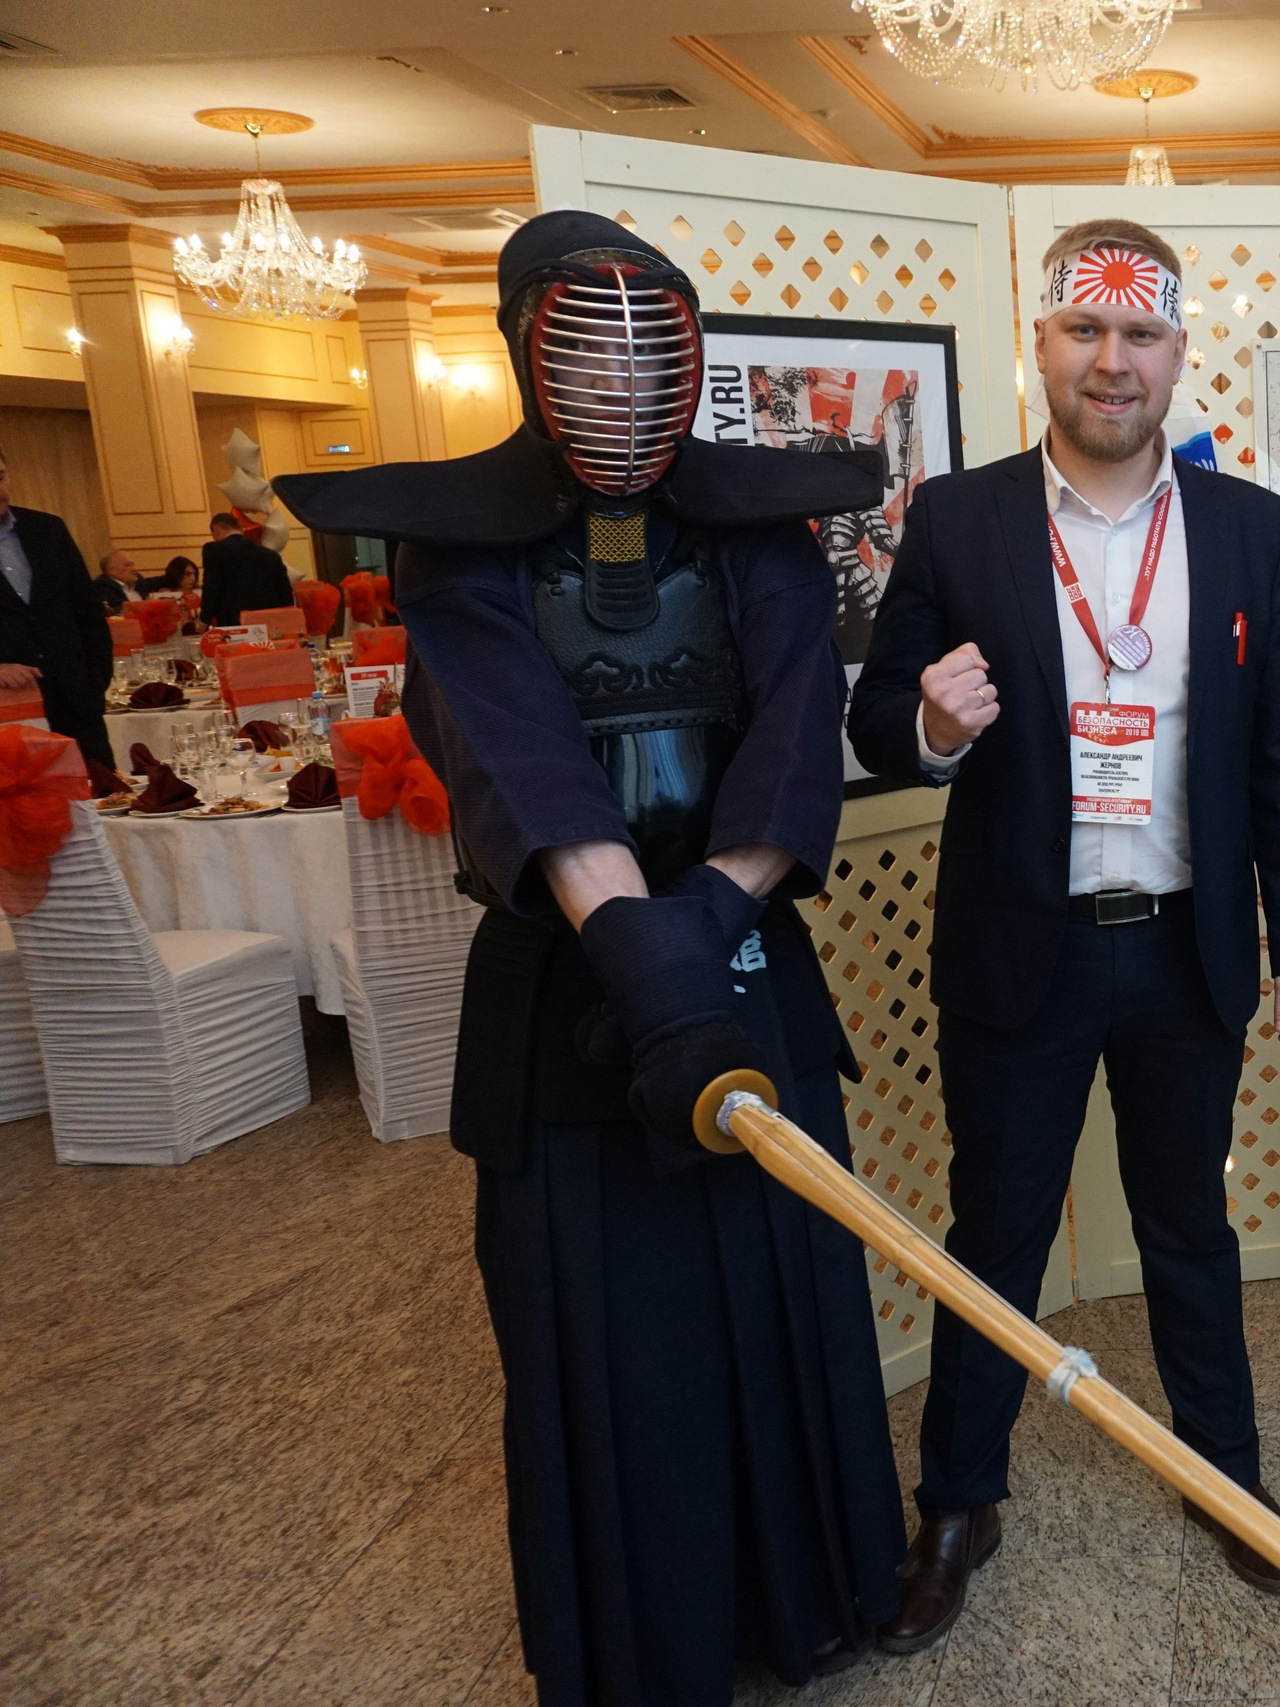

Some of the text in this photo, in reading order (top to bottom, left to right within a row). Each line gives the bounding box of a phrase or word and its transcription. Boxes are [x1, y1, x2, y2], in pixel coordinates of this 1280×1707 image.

[1151, 521, 1162, 549] РАБОТАТЬ
[1147, 549, 1156, 566] НАДО
[1118, 710, 1150, 719] ФОРУМ
[1077, 715, 1149, 728] БЕЗОПАСНОСТЬ
[1077, 725, 1140, 736] БИЗНЕСА 2019
[1080, 751, 1143, 761] АЛЕКСАНДР АНДРЕЕВИЧ
[1100, 761, 1122, 769] ЖЕРНОВ
[1072, 800, 1147, 815] FORUM-SECURITY.RU
